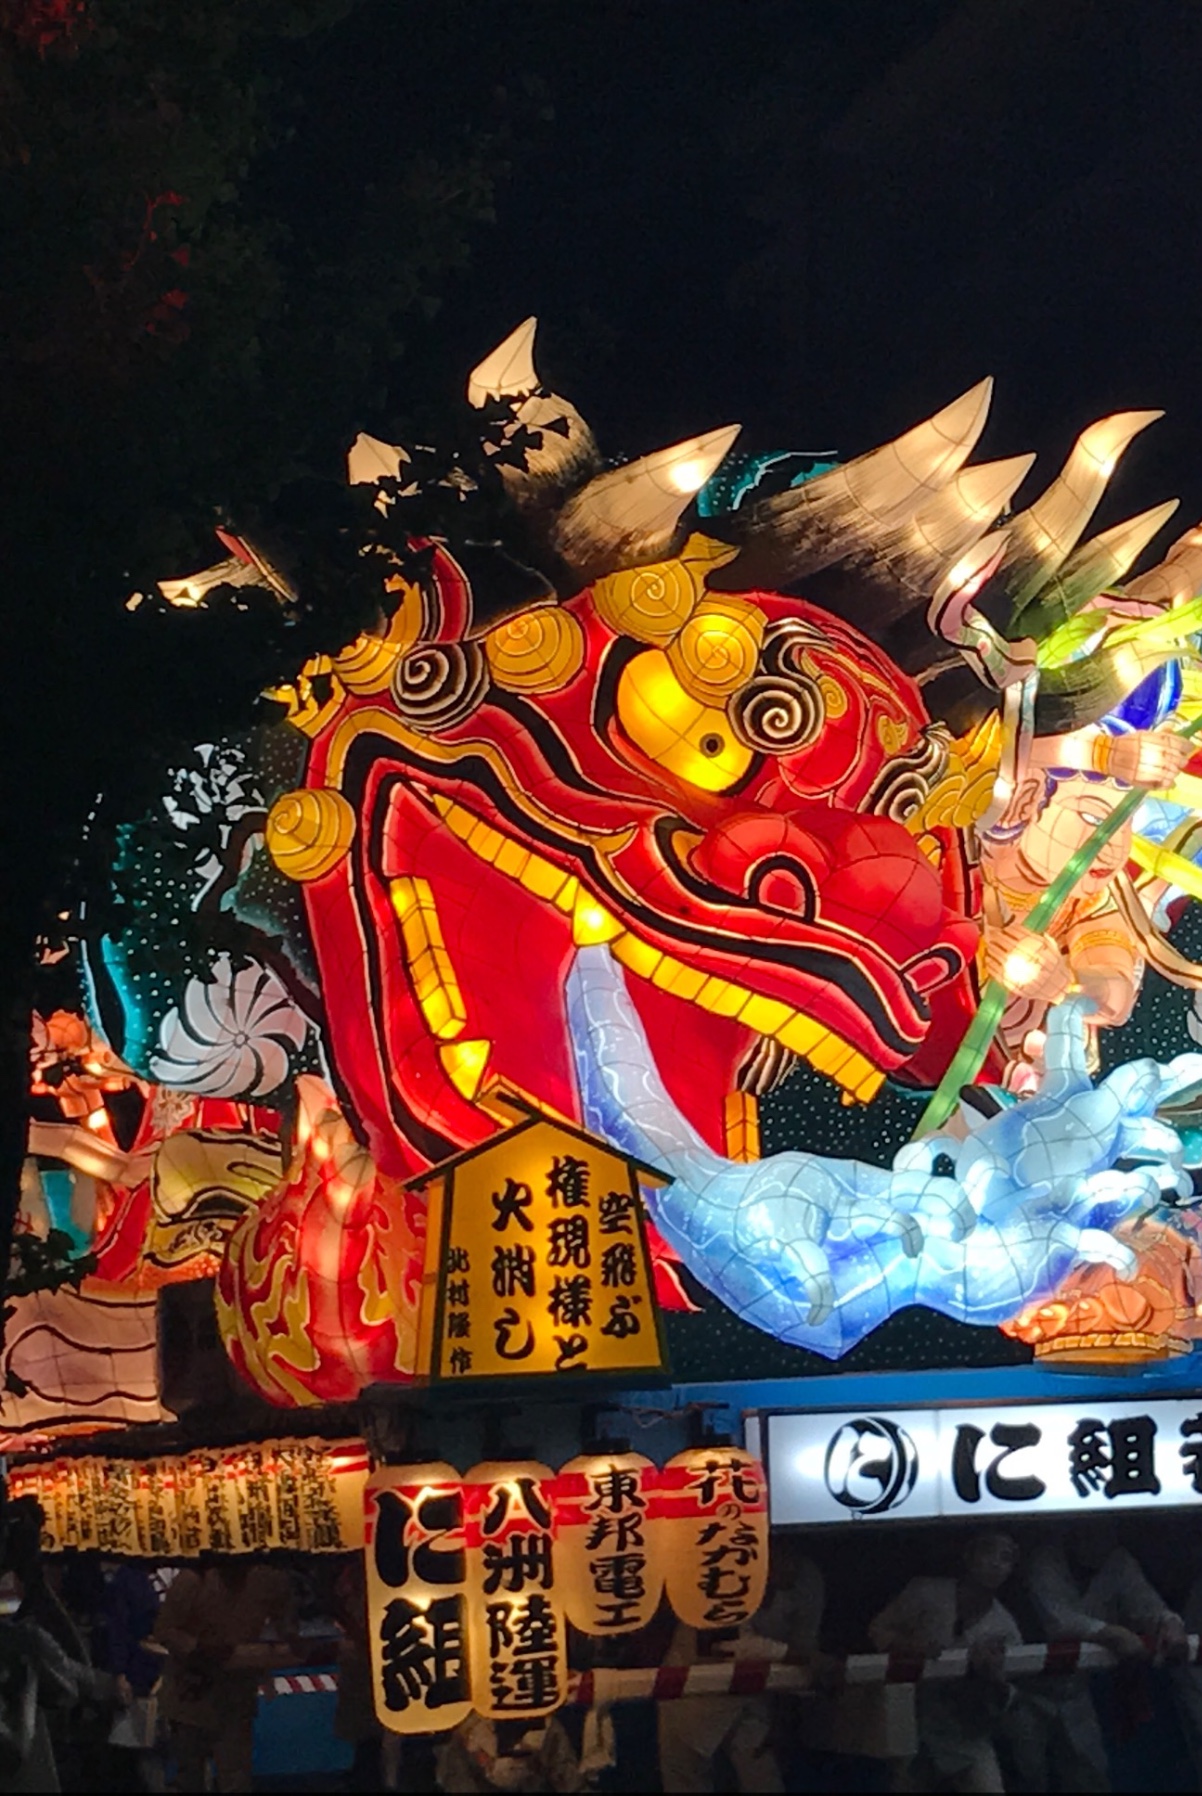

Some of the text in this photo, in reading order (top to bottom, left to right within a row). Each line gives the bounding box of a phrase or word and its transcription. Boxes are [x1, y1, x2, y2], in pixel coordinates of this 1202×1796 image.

[545, 1154, 594, 1372] 権現様と
[598, 1191, 642, 1339] 空飛ぶ
[373, 1487, 467, 1712] に組
[483, 1478, 559, 1711] 八洲陸運
[585, 1464, 646, 1627] 東邦電工
[688, 1458, 761, 1625] 花のなかむら
